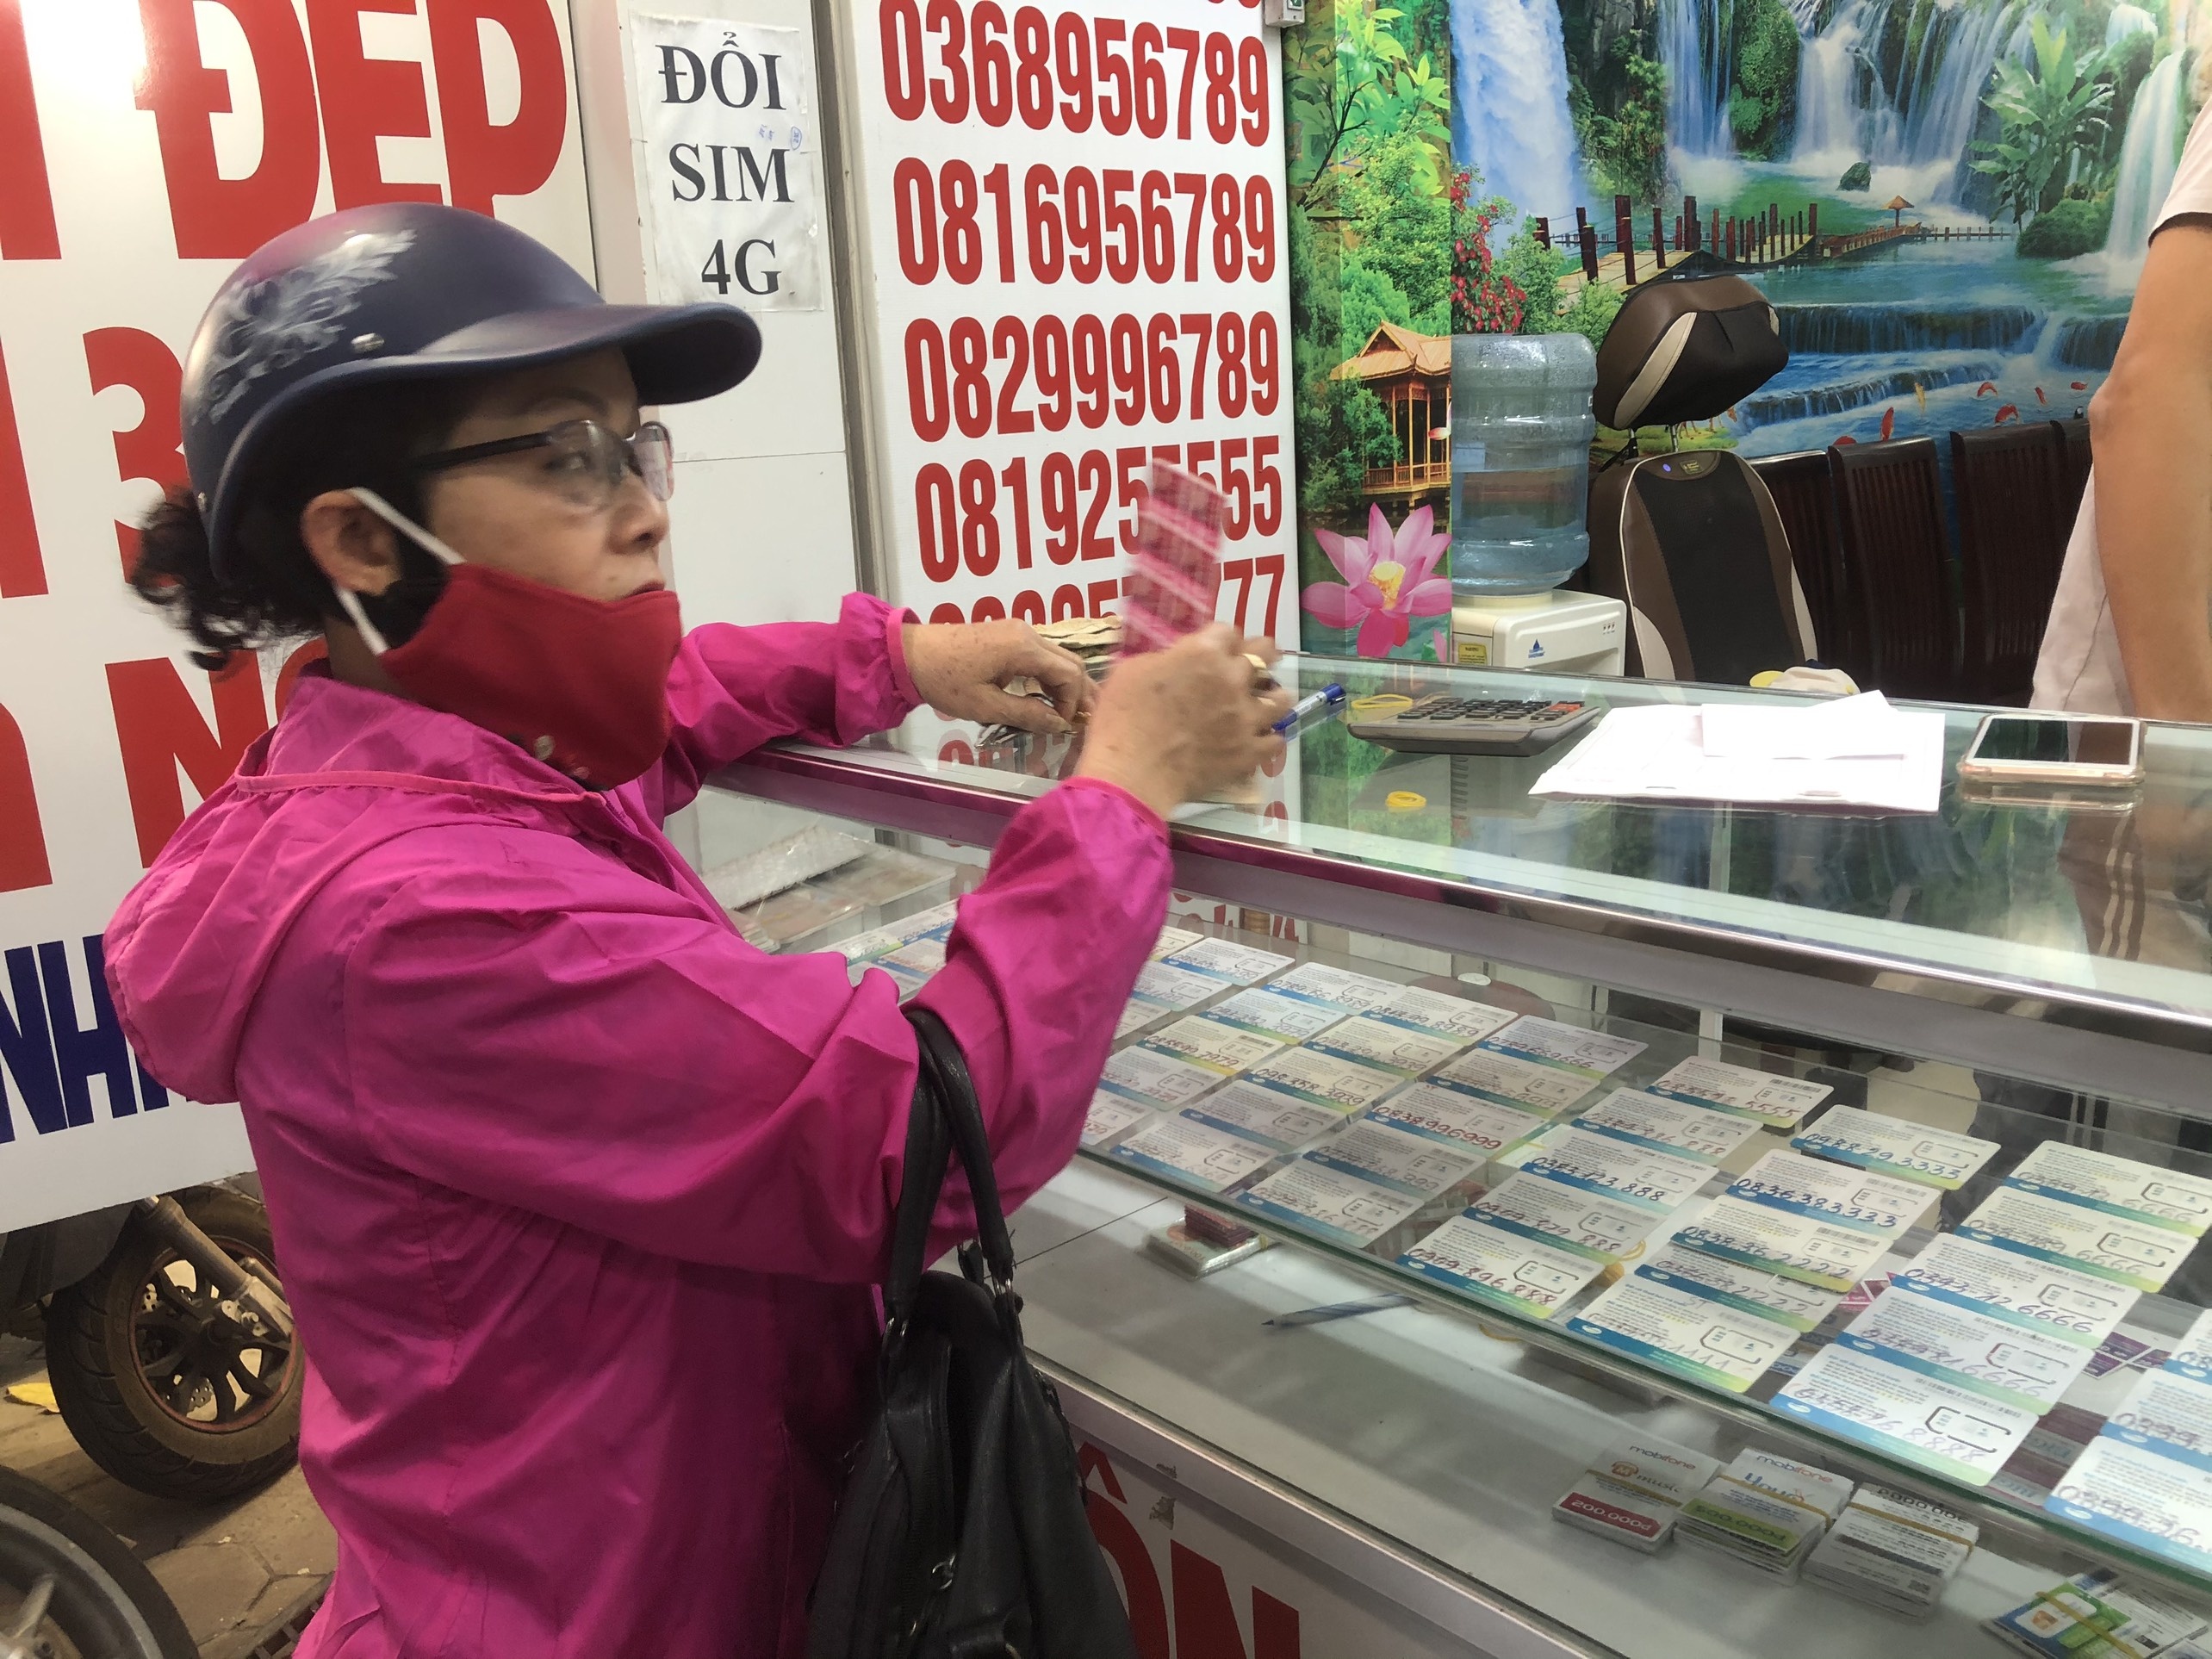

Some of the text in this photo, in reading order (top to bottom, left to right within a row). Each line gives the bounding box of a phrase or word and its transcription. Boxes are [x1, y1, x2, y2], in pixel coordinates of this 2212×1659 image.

[655, 31, 786, 110] ĐỔI
[879, 0, 1271, 146] 0368956789
[668, 142, 795, 202] SIM
[892, 157, 1277, 286] 0816956789
[701, 239, 782, 295] 4G
[904, 310, 1279, 443] 0829996789
[915, 436, 1283, 583] 08192555
[1629, 1445, 1696, 1469] mobifone
[1756, 1455, 1833, 1483] mobifone
